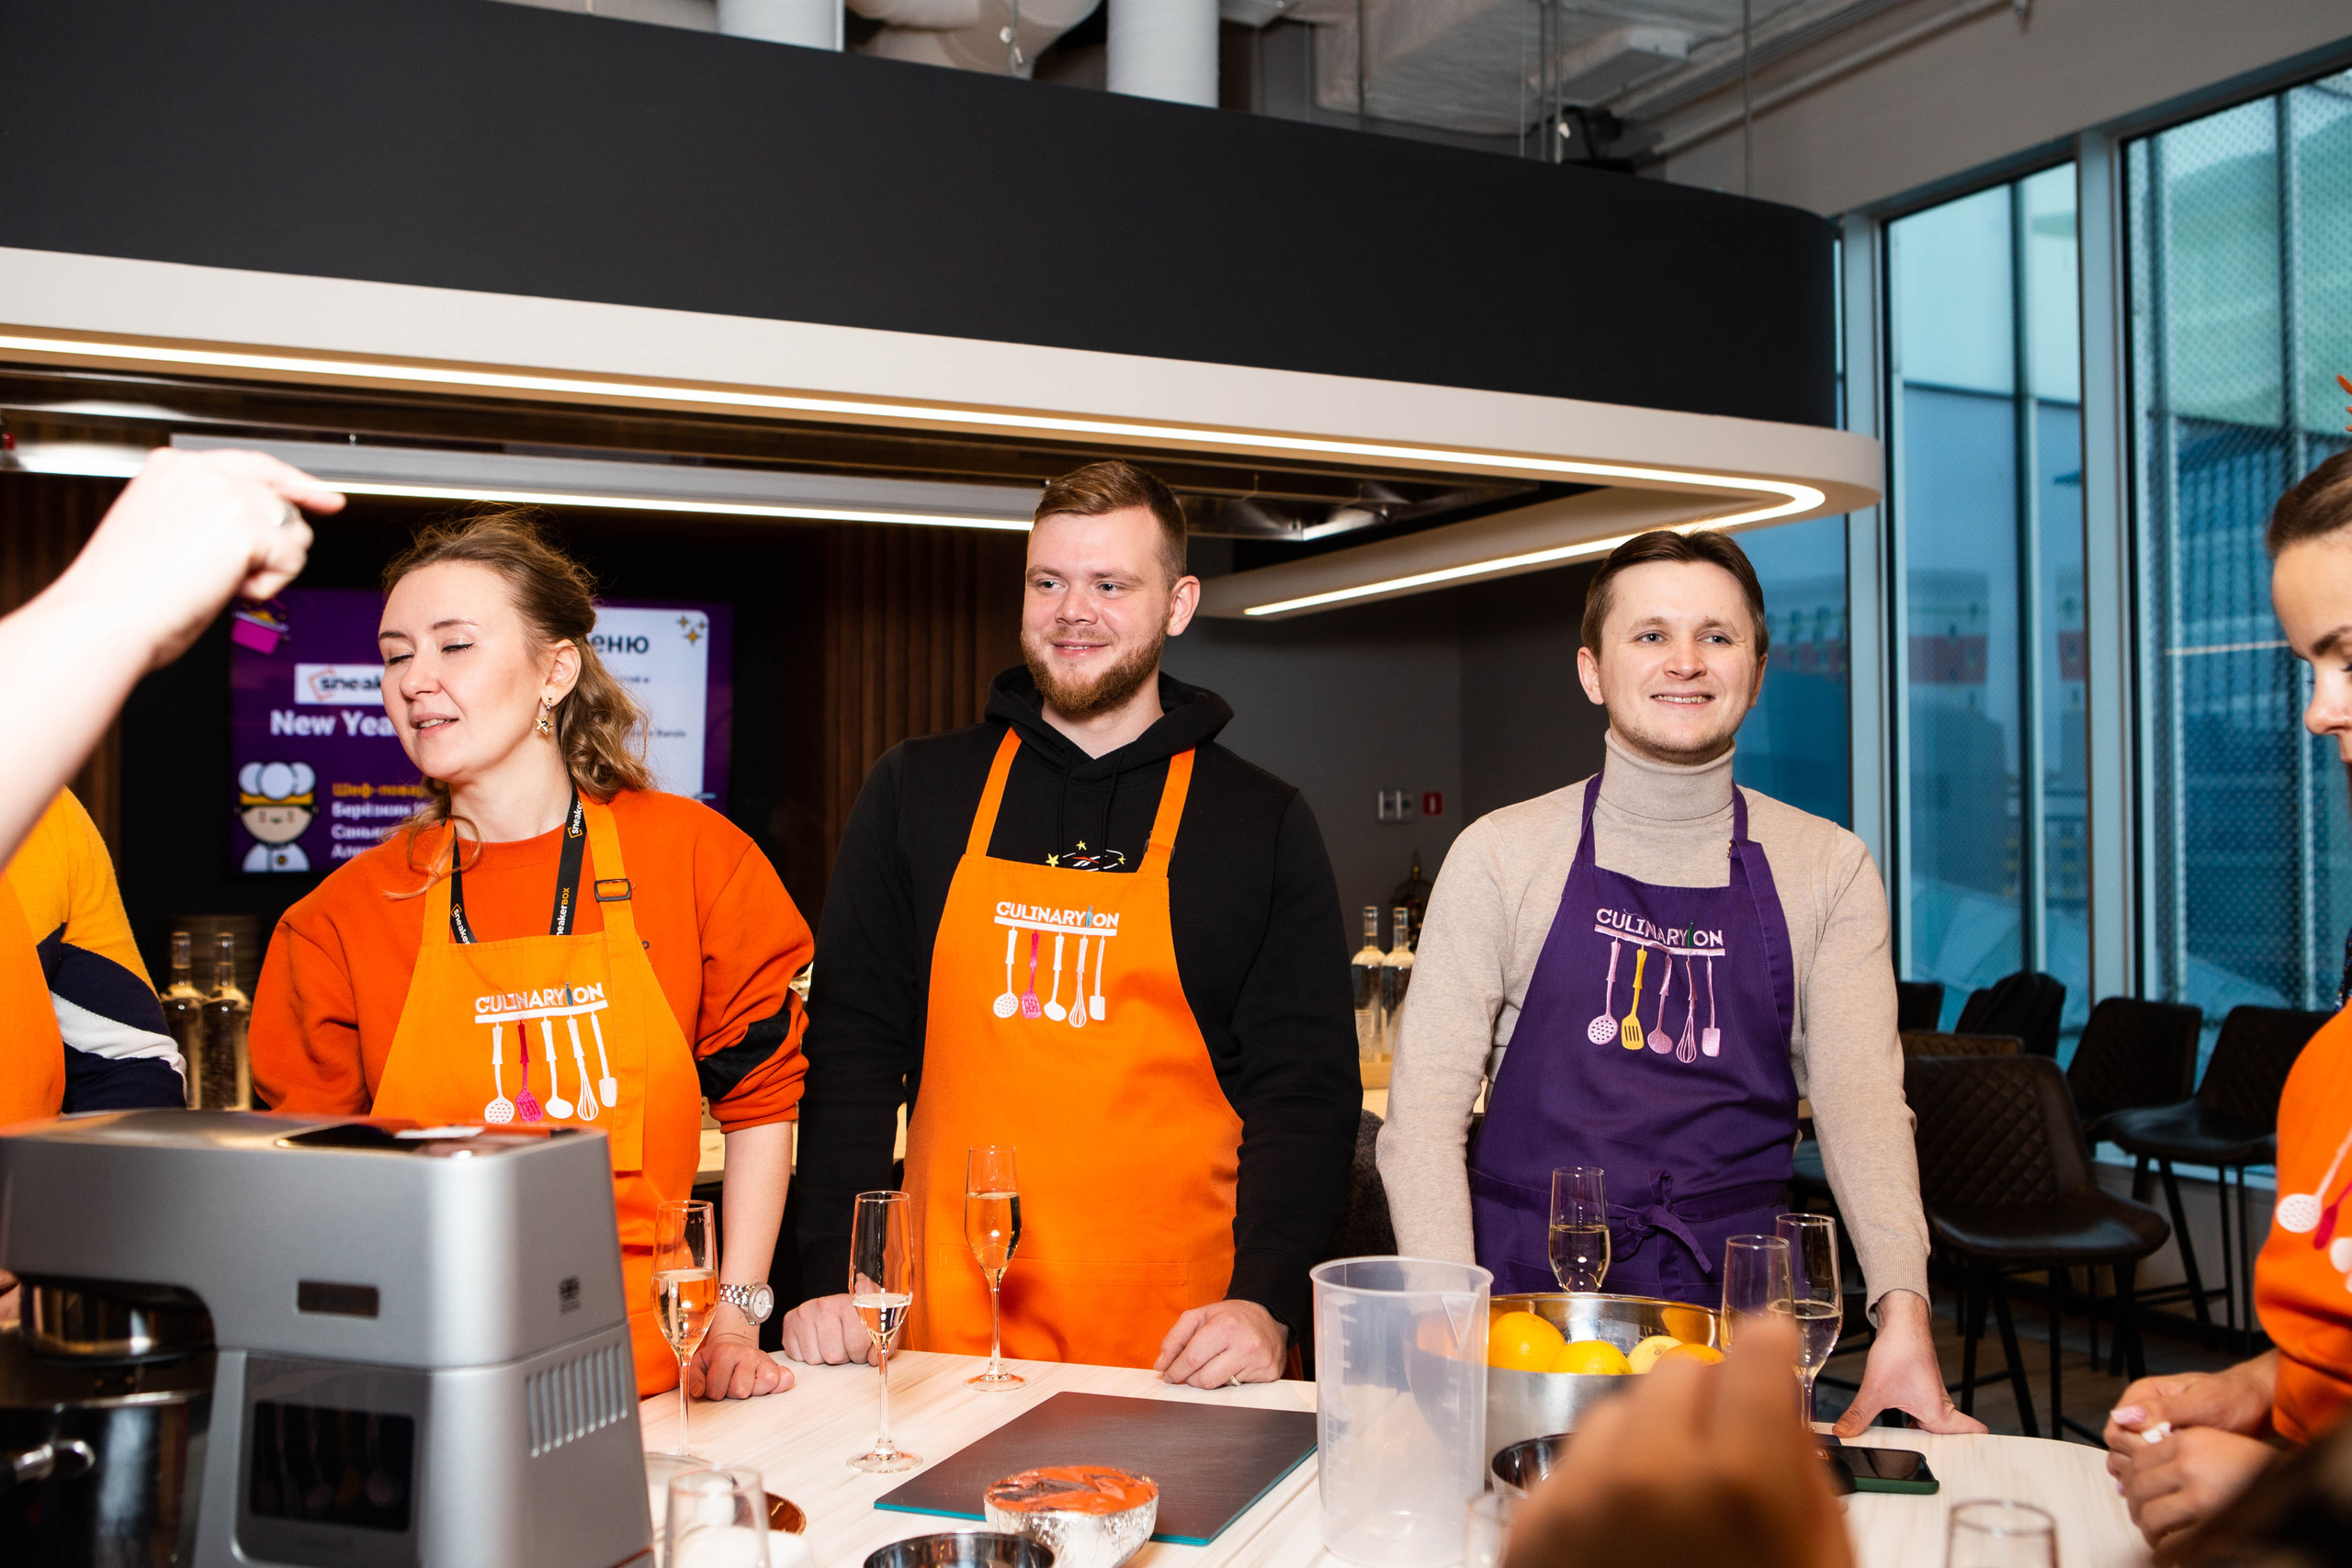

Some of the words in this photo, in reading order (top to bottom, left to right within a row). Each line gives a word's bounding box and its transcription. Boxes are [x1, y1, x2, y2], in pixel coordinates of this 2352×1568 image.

[591, 635, 649, 654] еню
[321, 673, 382, 691] sneak
[270, 709, 336, 737] New
[341, 709, 397, 737] Yea
[571, 799, 582, 835] sneaker
[556, 887, 570, 937] neakerBOX
